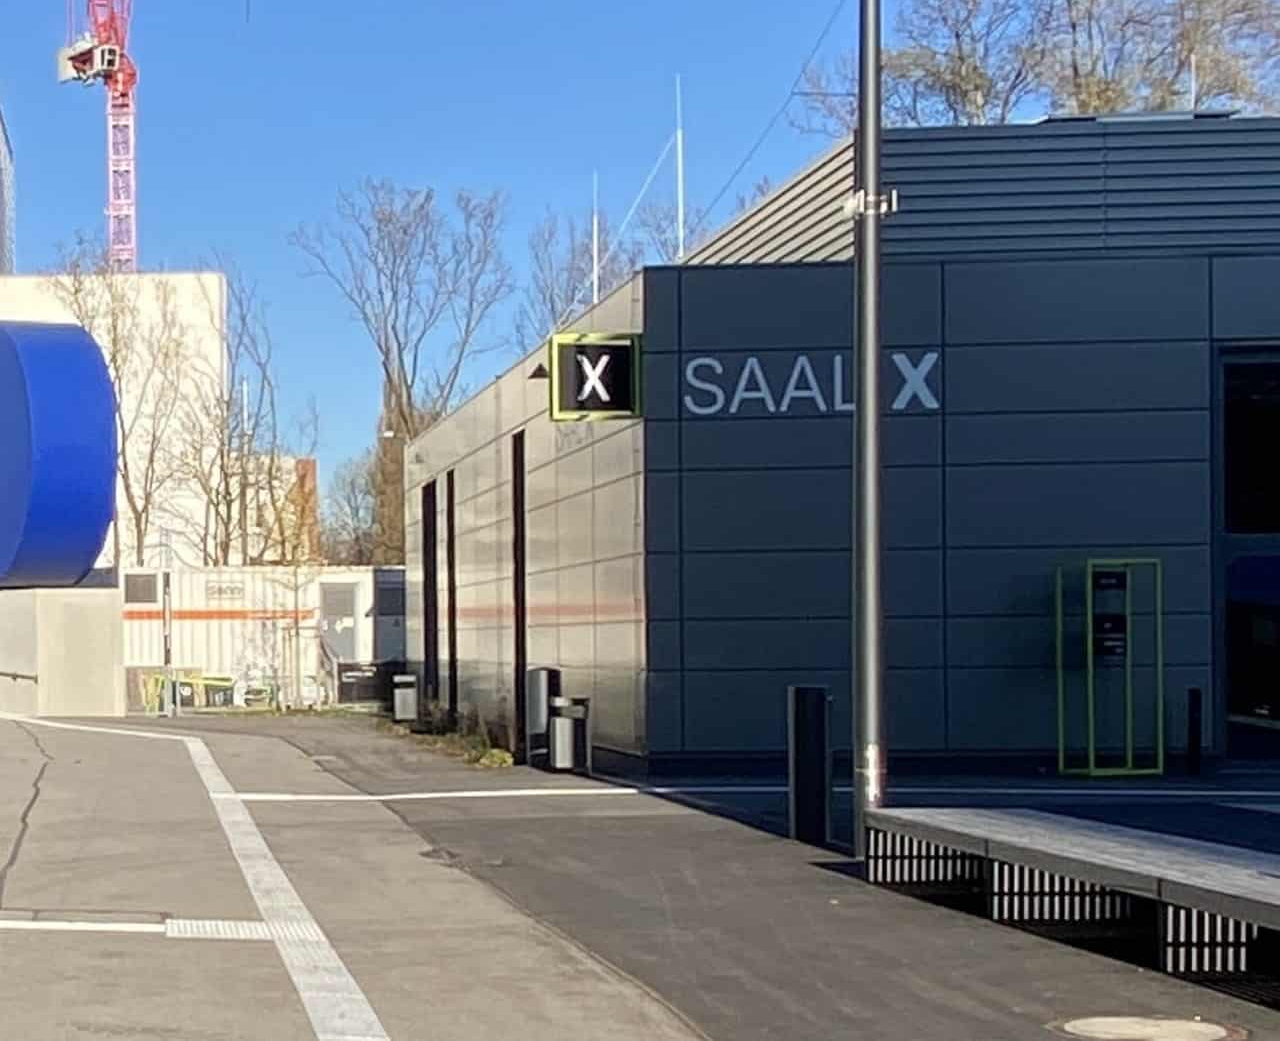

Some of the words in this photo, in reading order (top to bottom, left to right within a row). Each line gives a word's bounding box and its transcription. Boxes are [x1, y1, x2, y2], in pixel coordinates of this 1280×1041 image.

[576, 354, 611, 402] X
[683, 354, 857, 415] SAAL
[891, 352, 940, 410] X
